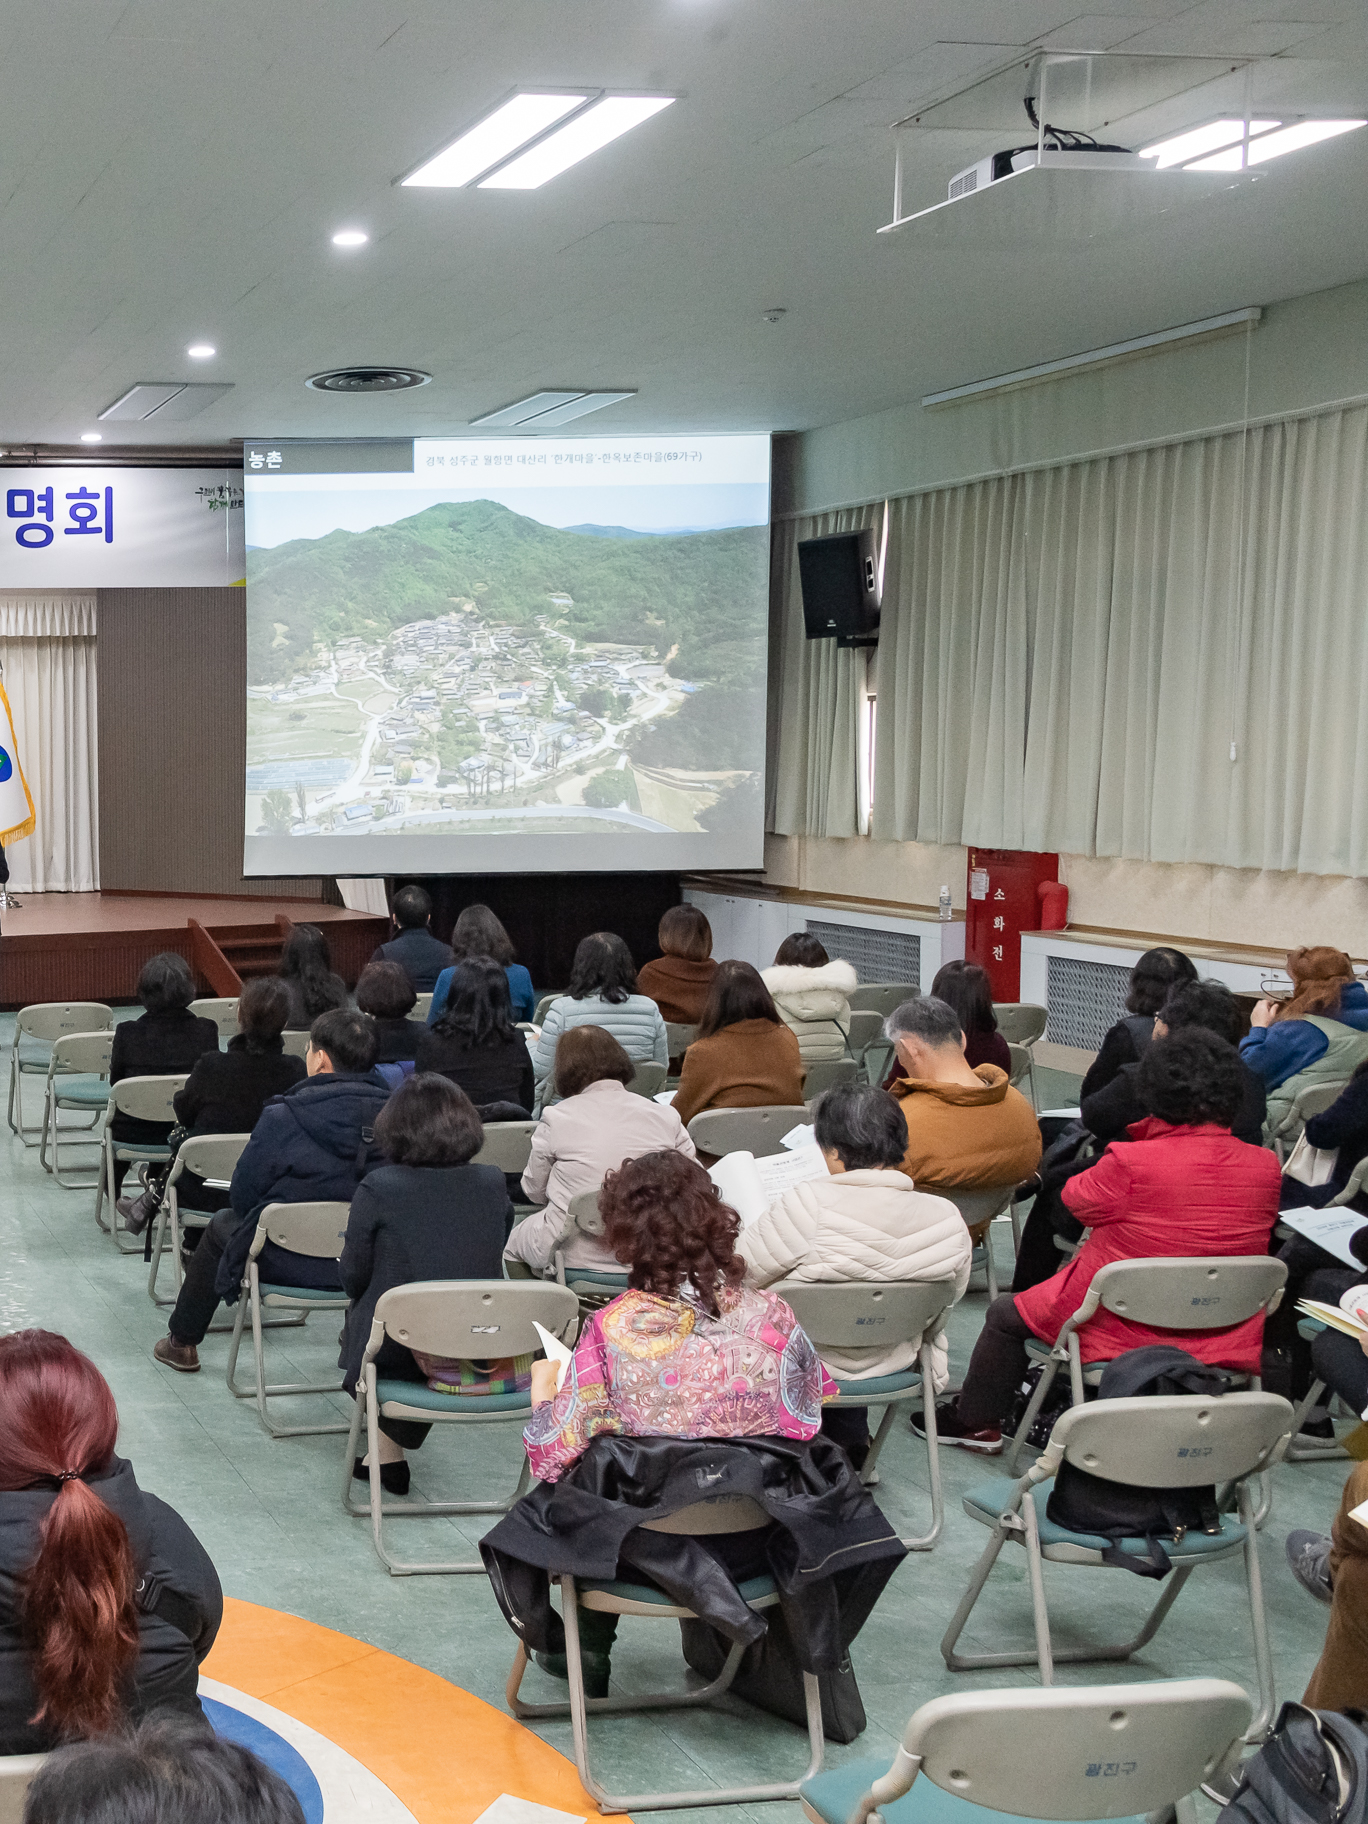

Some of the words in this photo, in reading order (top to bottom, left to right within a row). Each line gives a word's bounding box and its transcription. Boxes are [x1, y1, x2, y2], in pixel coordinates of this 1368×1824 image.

[248, 450, 283, 469] 농촌
[426, 456, 445, 467] 경북
[449, 455, 479, 467] 성주군
[516, 454, 547, 465] 대산리
[992, 888, 1006, 961] 소화전
[1085, 1762, 1137, 1777] 광진구
